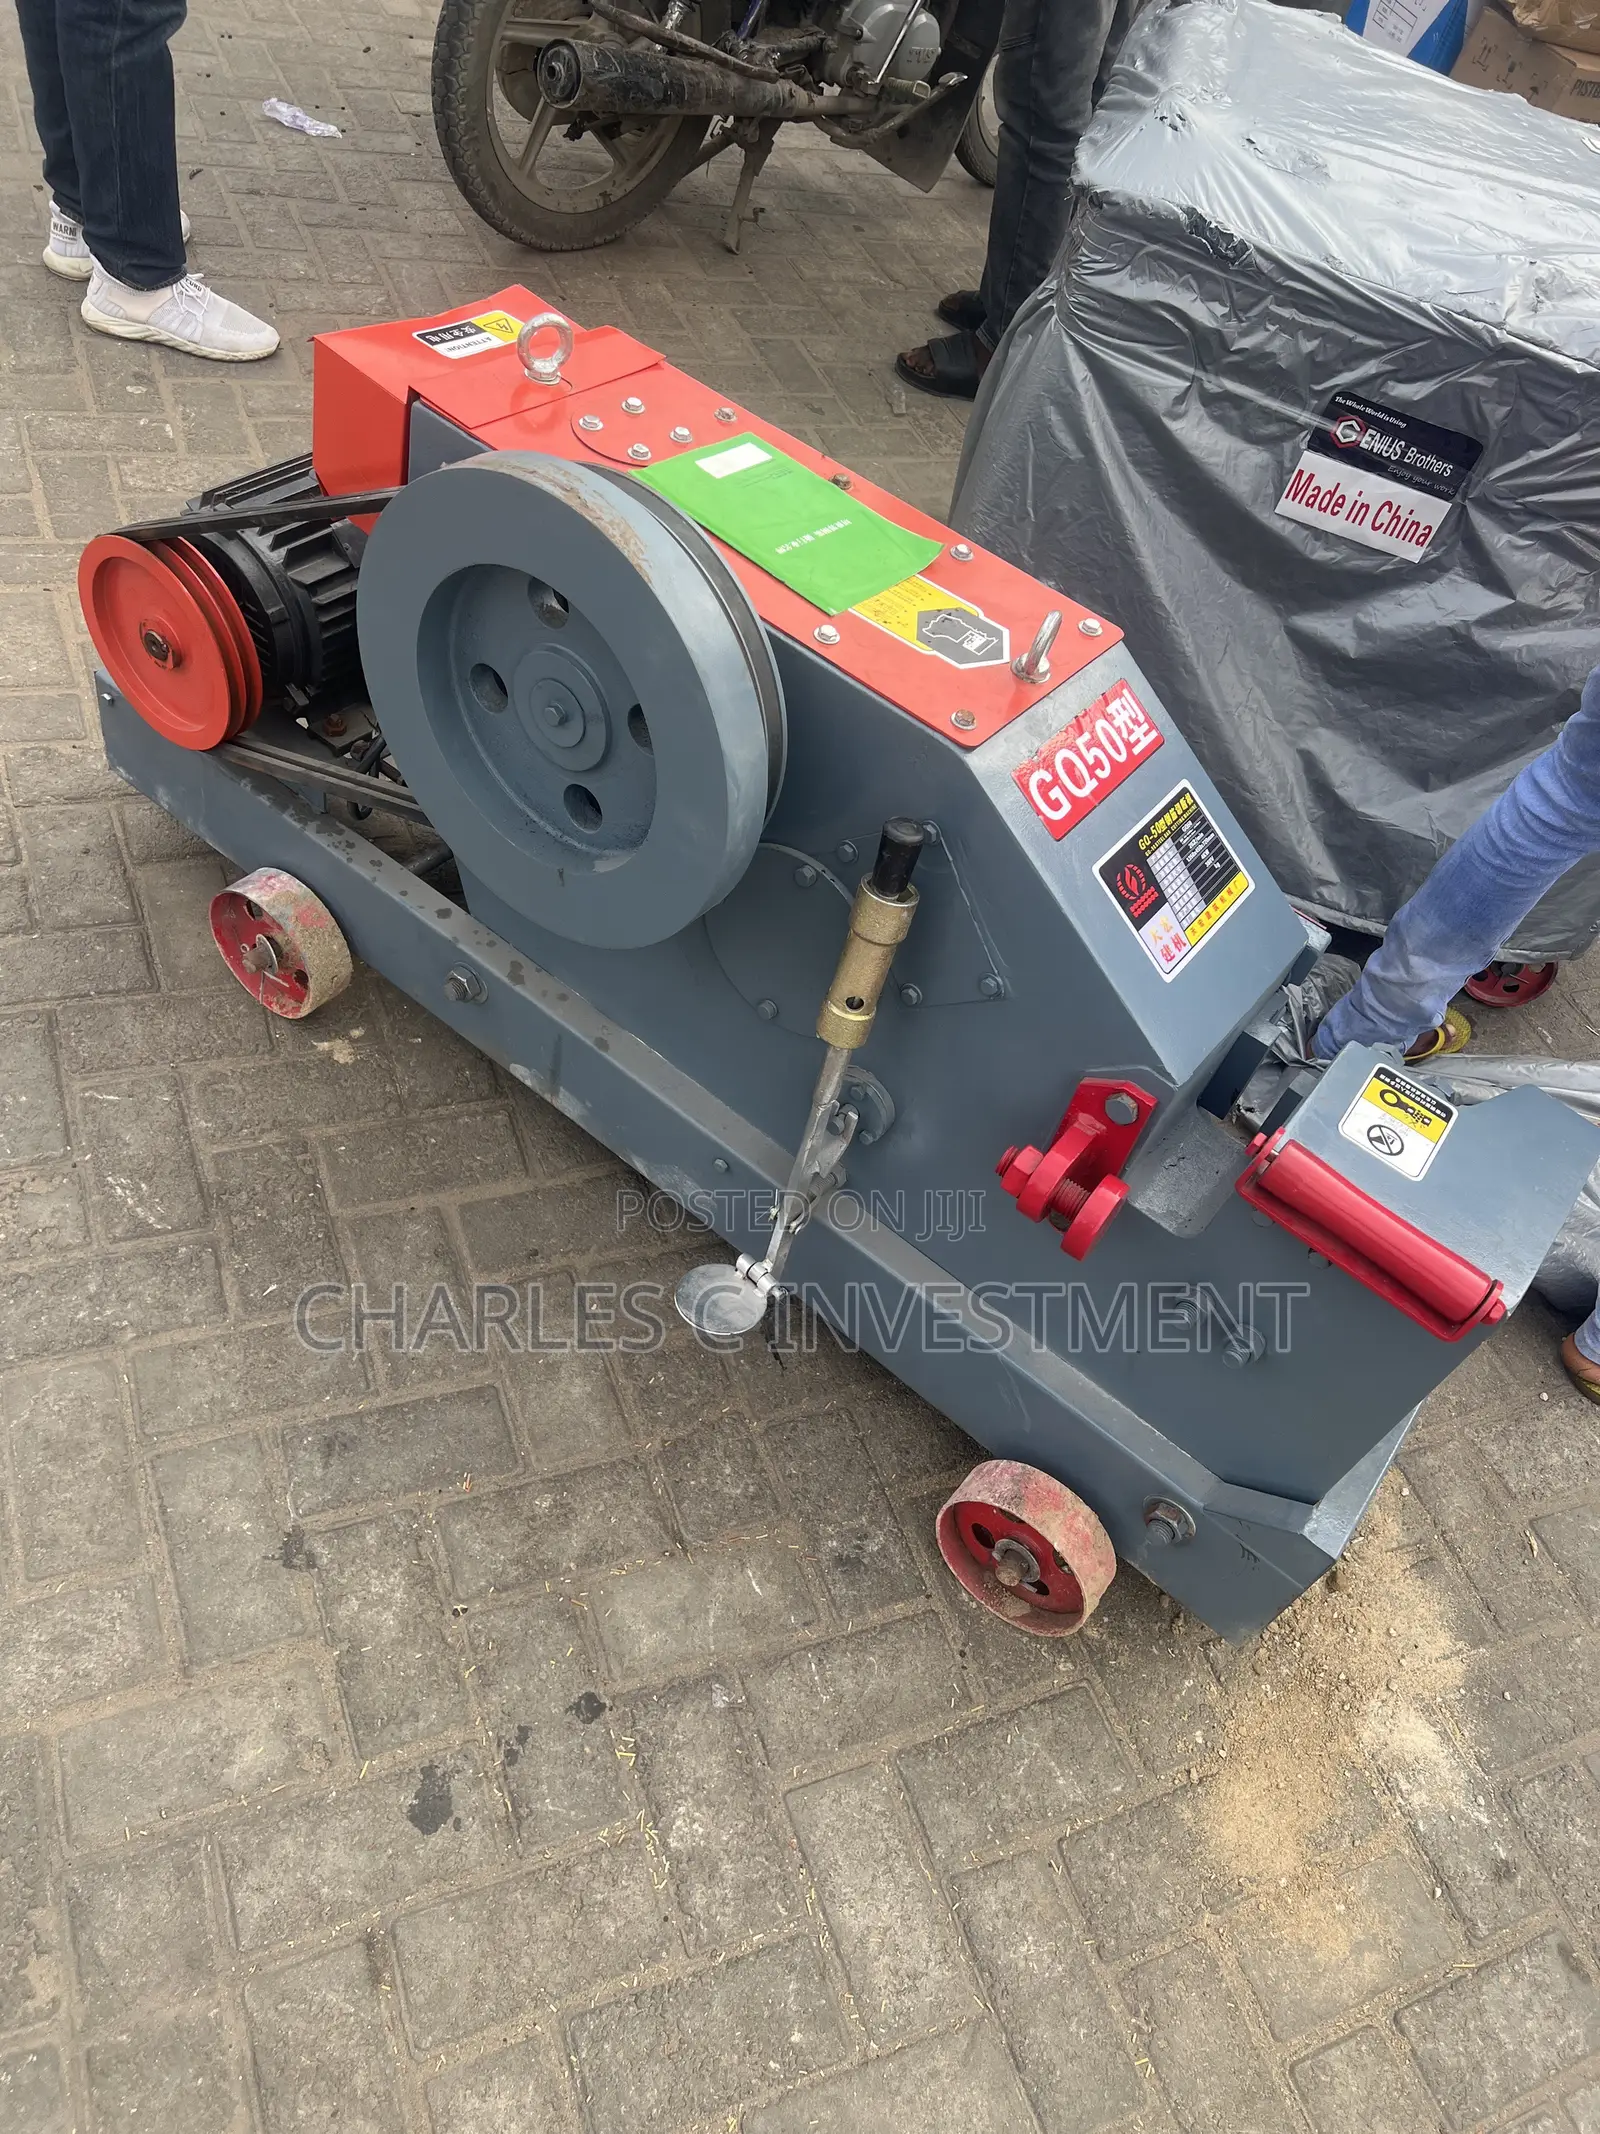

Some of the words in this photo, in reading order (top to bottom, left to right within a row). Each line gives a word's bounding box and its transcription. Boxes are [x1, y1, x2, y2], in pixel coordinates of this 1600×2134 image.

[426, 325, 476, 343] 安全用电
[1335, 396, 1346, 405] The
[1345, 399, 1365, 412] Whole
[1365, 407, 1384, 419] World
[1389, 417, 1408, 429] Using
[1404, 447, 1454, 477] Brothers
[1388, 465, 1411, 480] Enjoy
[1413, 475, 1432, 485] your
[1434, 483, 1455, 496] work
[1284, 468, 1346, 517] Made
[1345, 490, 1370, 527] in
[1371, 500, 1433, 547] China
[1028, 688, 1158, 821] GQ50型
